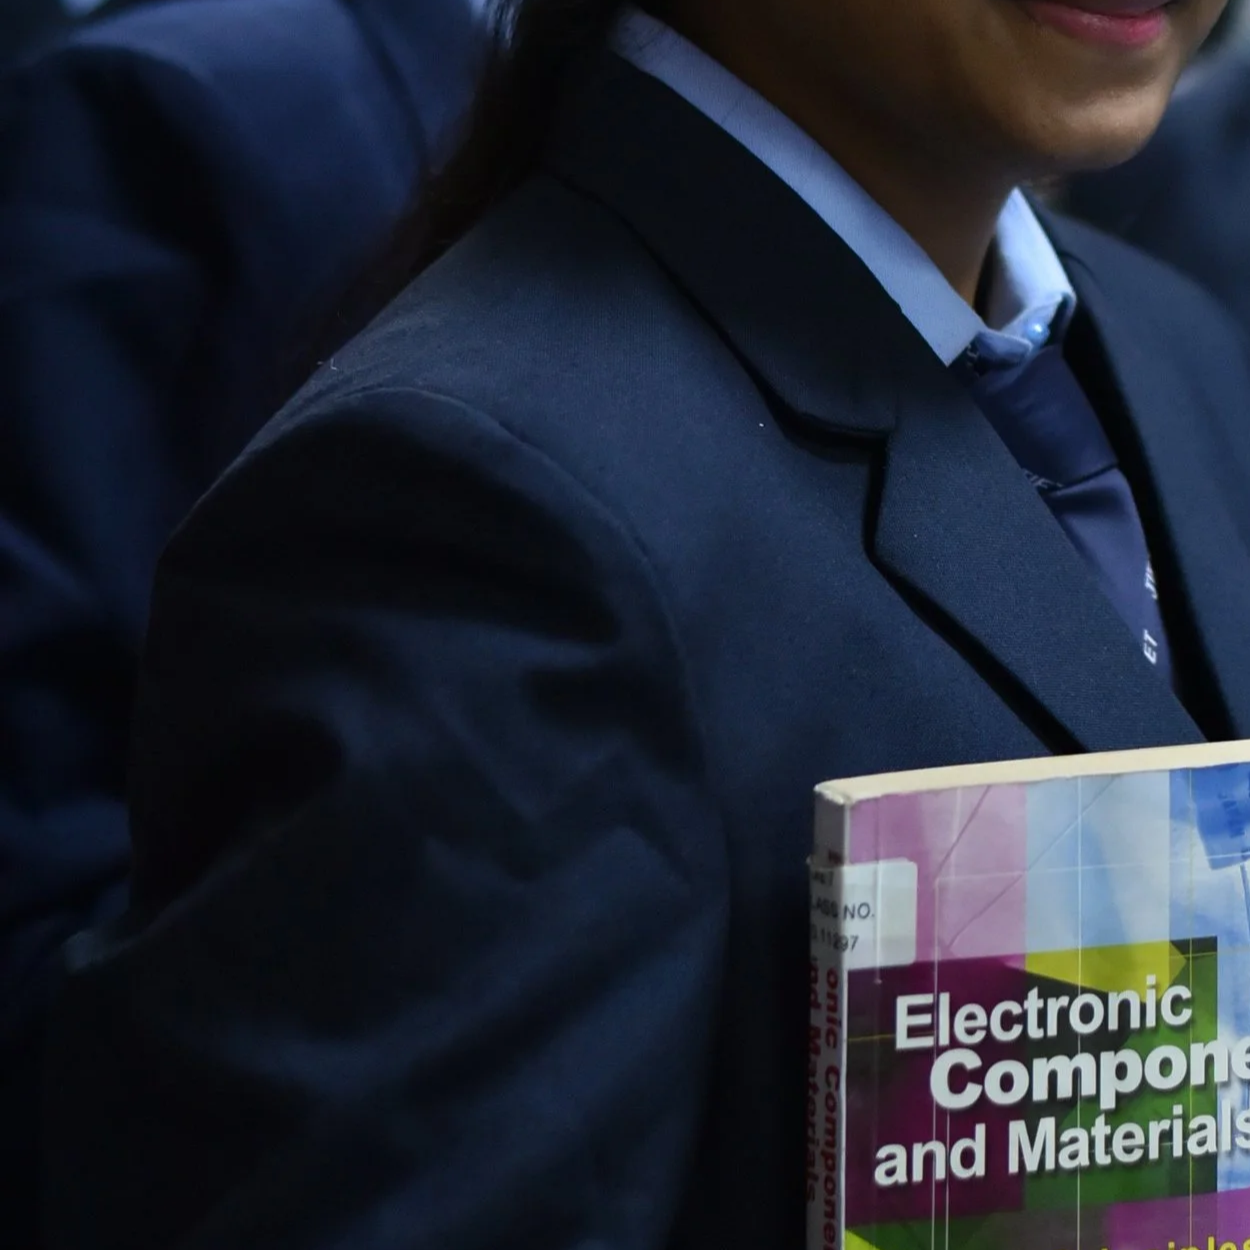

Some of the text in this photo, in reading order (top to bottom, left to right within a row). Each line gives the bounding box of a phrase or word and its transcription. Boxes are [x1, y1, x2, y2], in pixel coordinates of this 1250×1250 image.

[843, 901, 876, 920] NO.
[894, 974, 1193, 1051] Electronic
[874, 1138, 986, 1186] and
